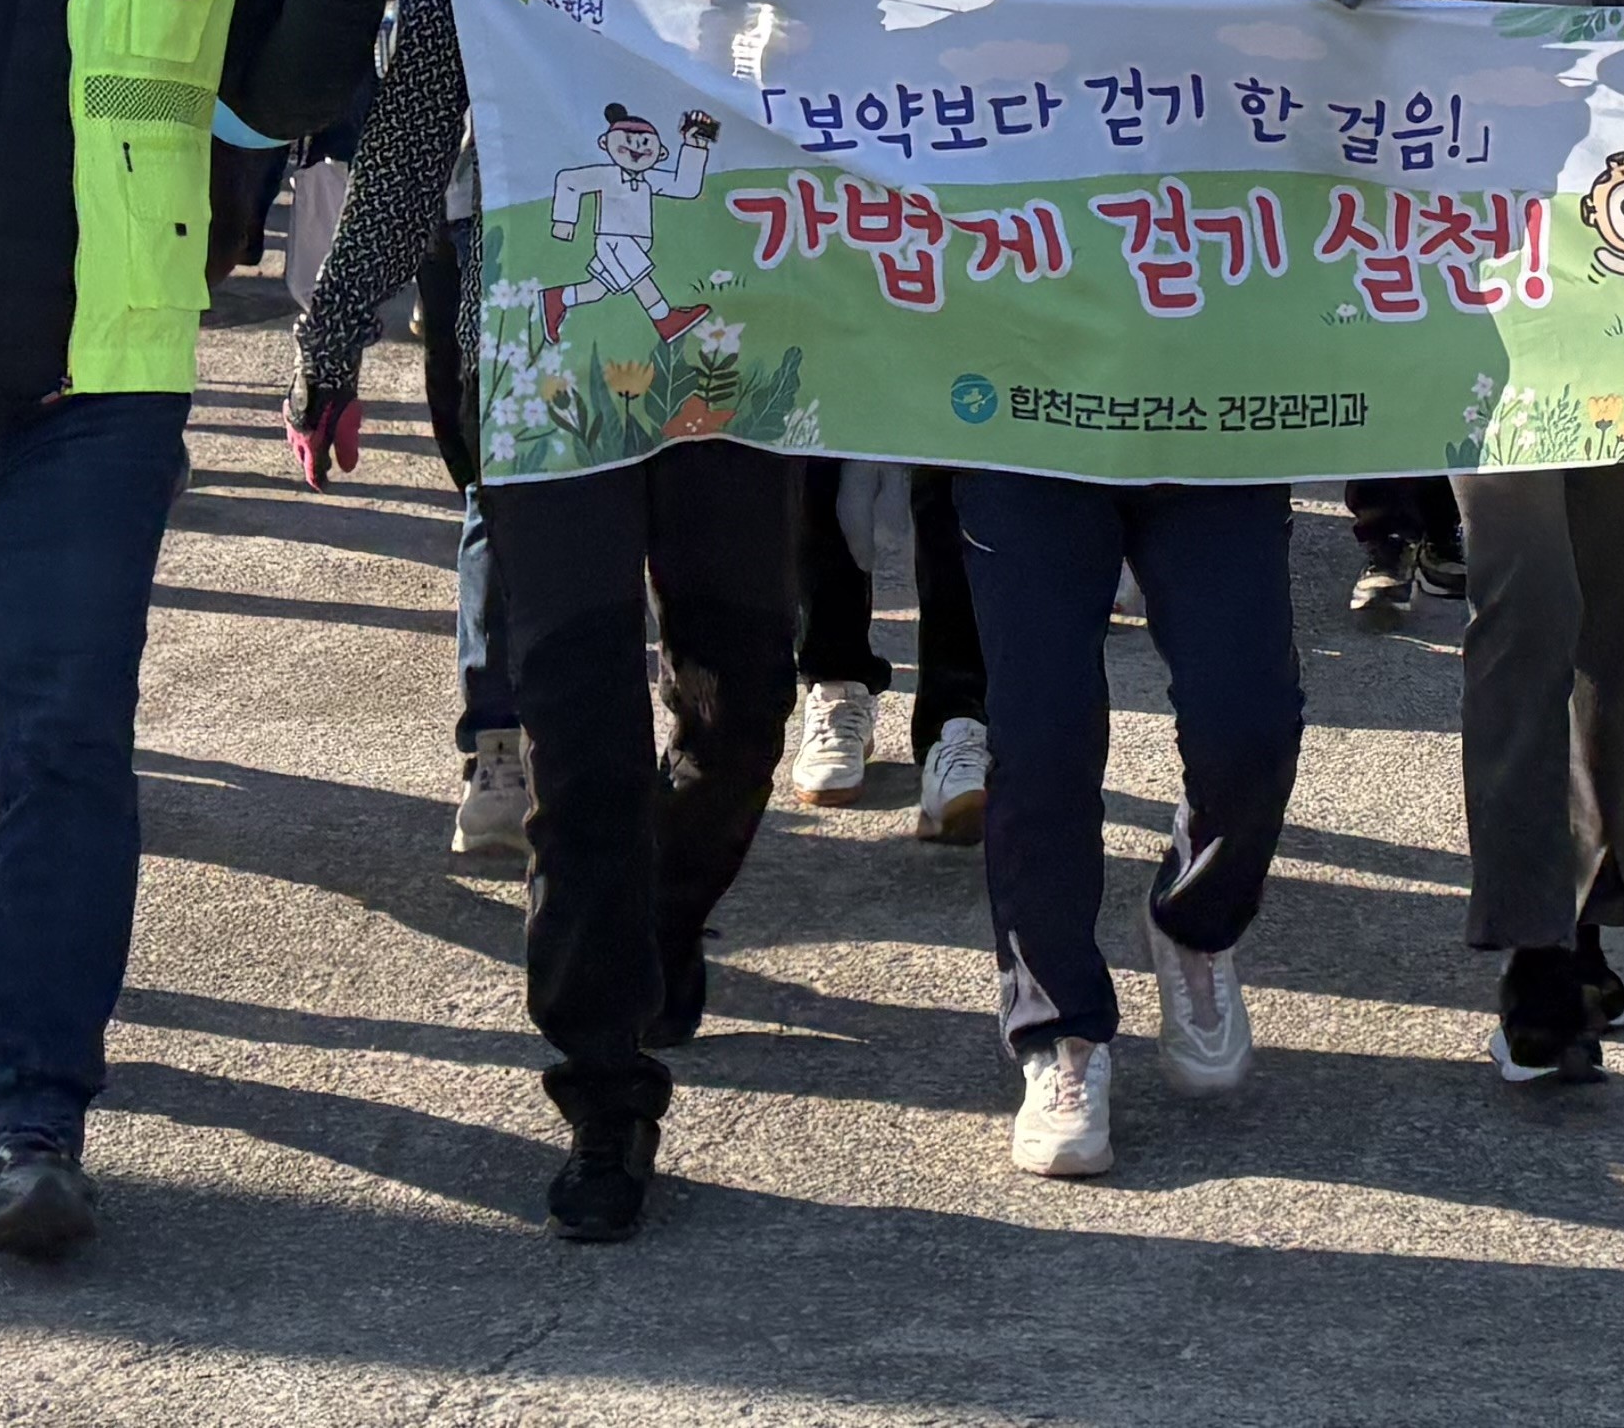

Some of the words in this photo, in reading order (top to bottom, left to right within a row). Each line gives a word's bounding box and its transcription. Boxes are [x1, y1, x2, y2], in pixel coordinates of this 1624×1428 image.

[762, 81, 1063, 159] 「보약보다
[1084, 67, 1204, 146] 걷기
[1234, 77, 1304, 142] 한
[1327, 90, 1490, 171] 걸음!」
[732, 178, 1064, 305] 가볍게
[1096, 185, 1281, 309] 걷기
[1320, 192, 1552, 314] 실천!
[1009, 384, 1208, 432] 합천군보건소
[1217, 392, 1370, 432] 건강관리과
